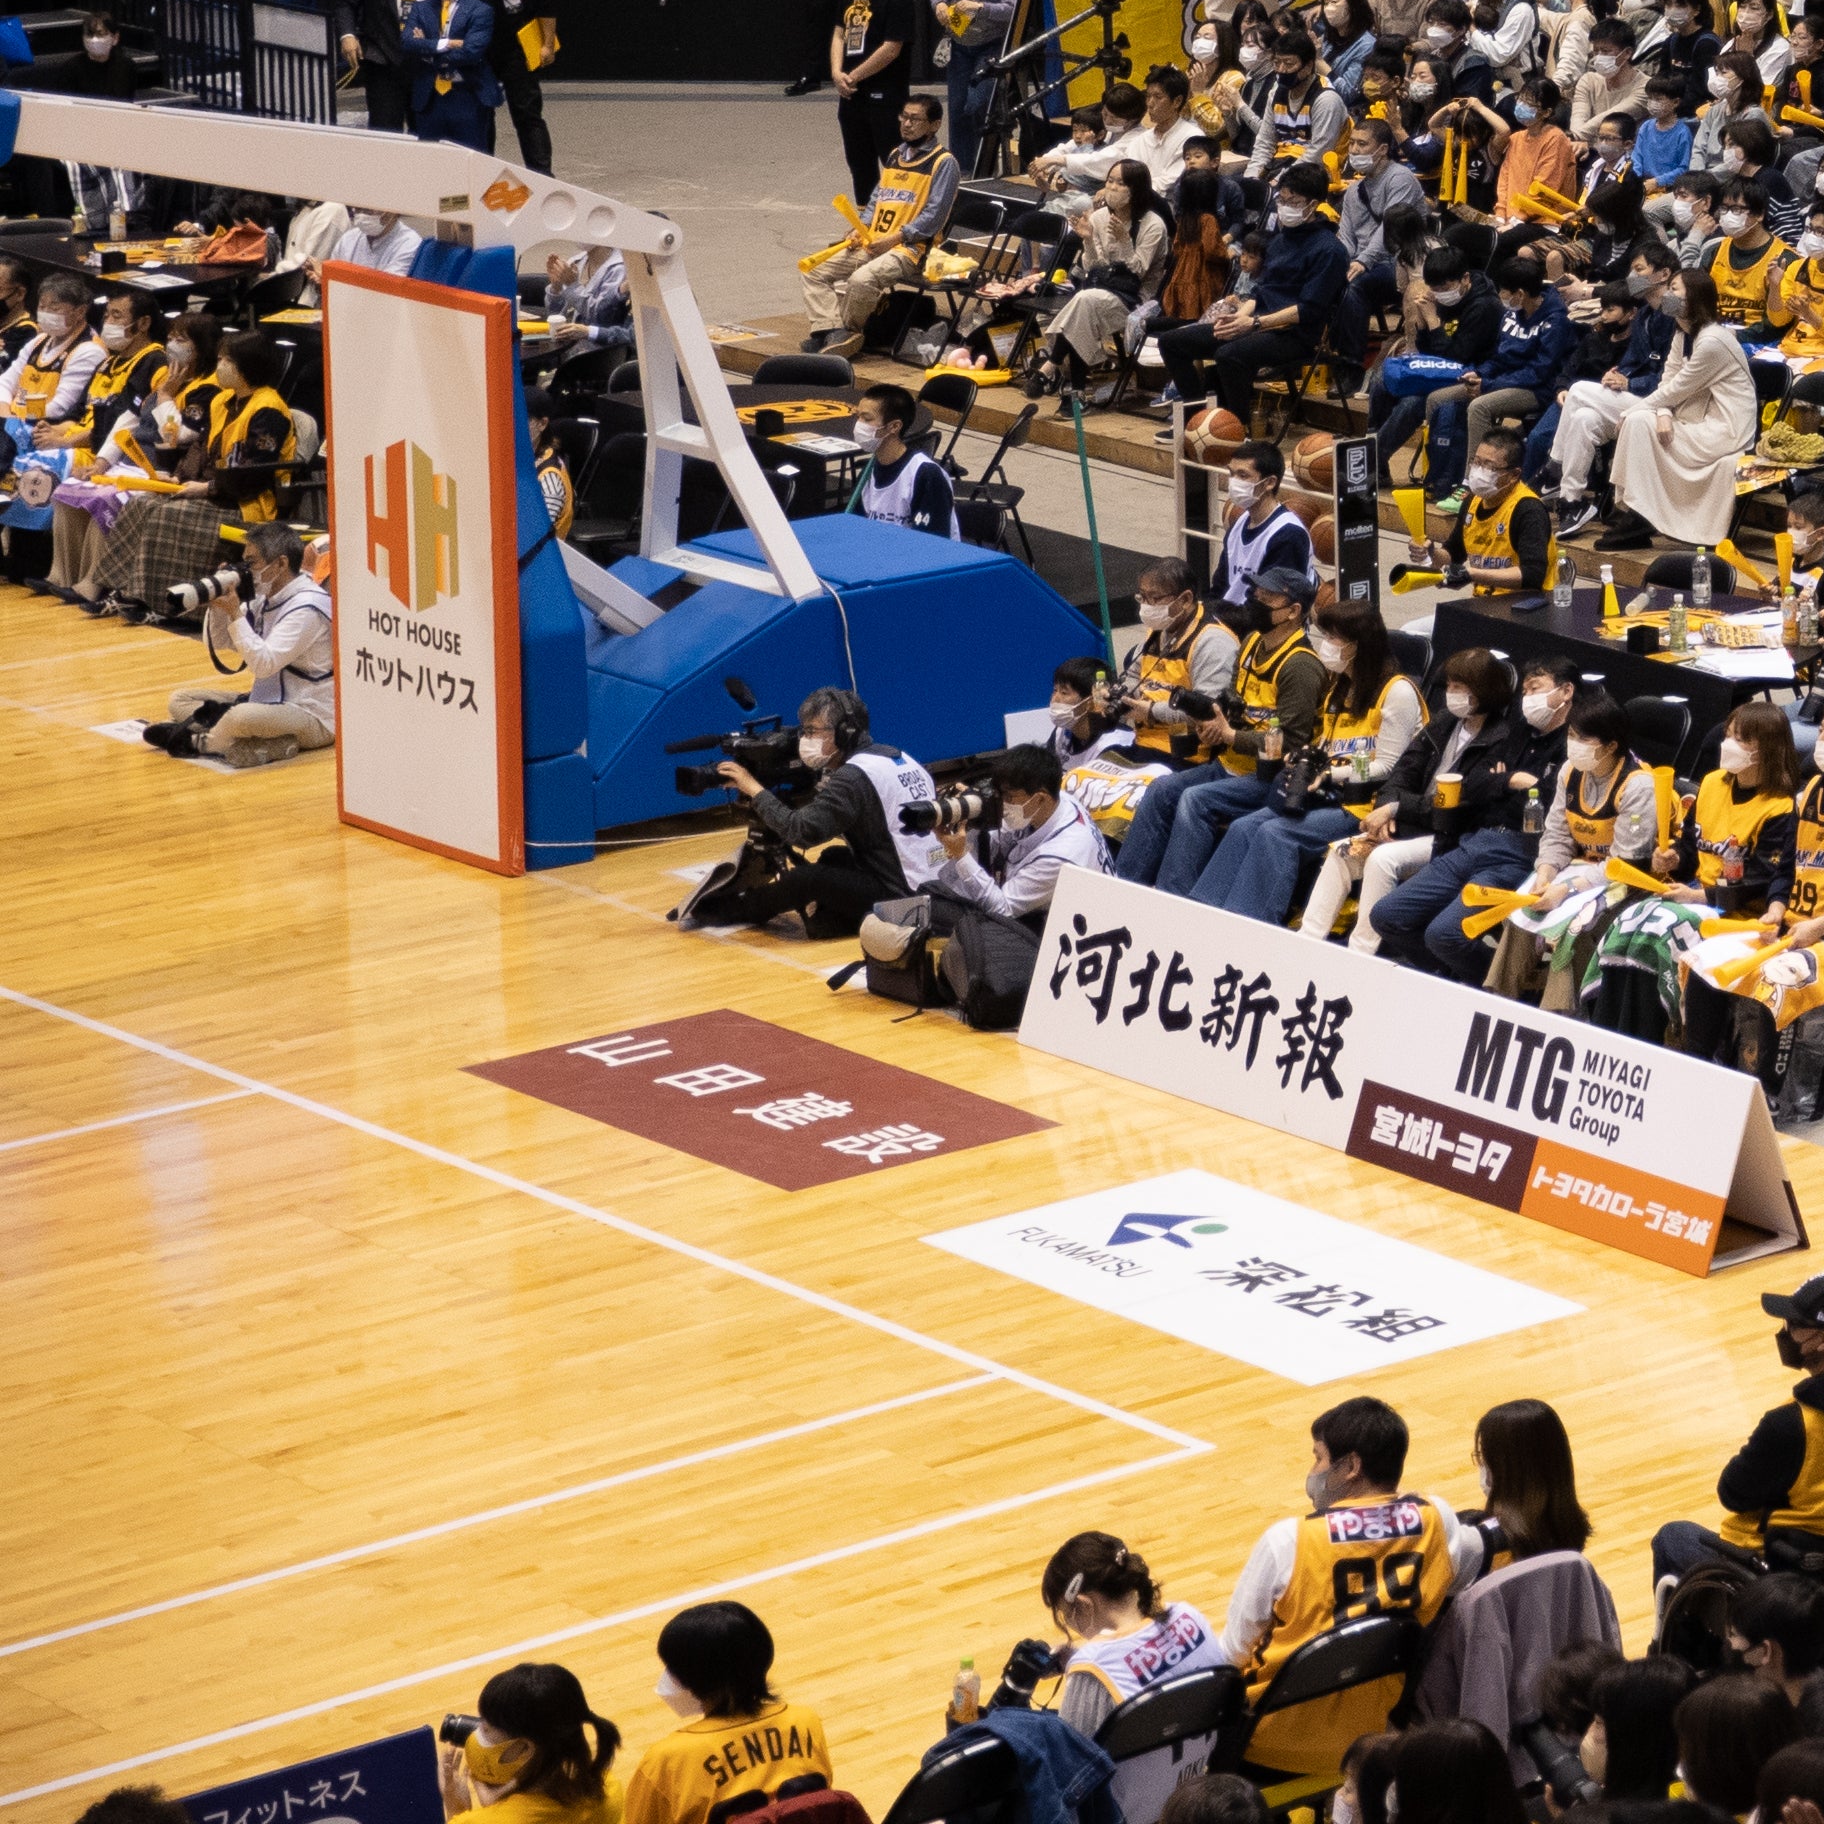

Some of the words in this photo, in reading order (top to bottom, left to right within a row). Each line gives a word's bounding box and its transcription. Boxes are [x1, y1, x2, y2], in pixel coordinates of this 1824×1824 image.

[914, 512, 931, 526] 44
[1344, 523, 1374, 536] molten
[368, 608, 403, 638] HOT
[407, 619, 462, 656] HOUSE
[355, 645, 479, 715] ホットハウス
[1049, 910, 1357, 1102] 河北新報
[564, 1033, 948, 1168] 山田建設
[1454, 1010, 1575, 1128] MTG
[1580, 1048, 1654, 1093] MIYAGI
[1568, 1105, 1624, 1149] Group
[1576, 1079, 1646, 1124] TOYOTA
[1371, 1102, 1514, 1182] 宮城トヨタ
[1526, 1163, 1713, 1248] トヨタカローラ宮城
[1007, 1224, 1152, 1280] FUKAMATSU
[1198, 1255, 1449, 1346] 深松組
[1331, 1504, 1421, 1541] やまや
[1333, 1551, 1424, 1625] 89
[1128, 1613, 1205, 1680] やまや
[704, 1724, 817, 1787] SENDAI
[203, 1768, 367, 1824] フィットネス
